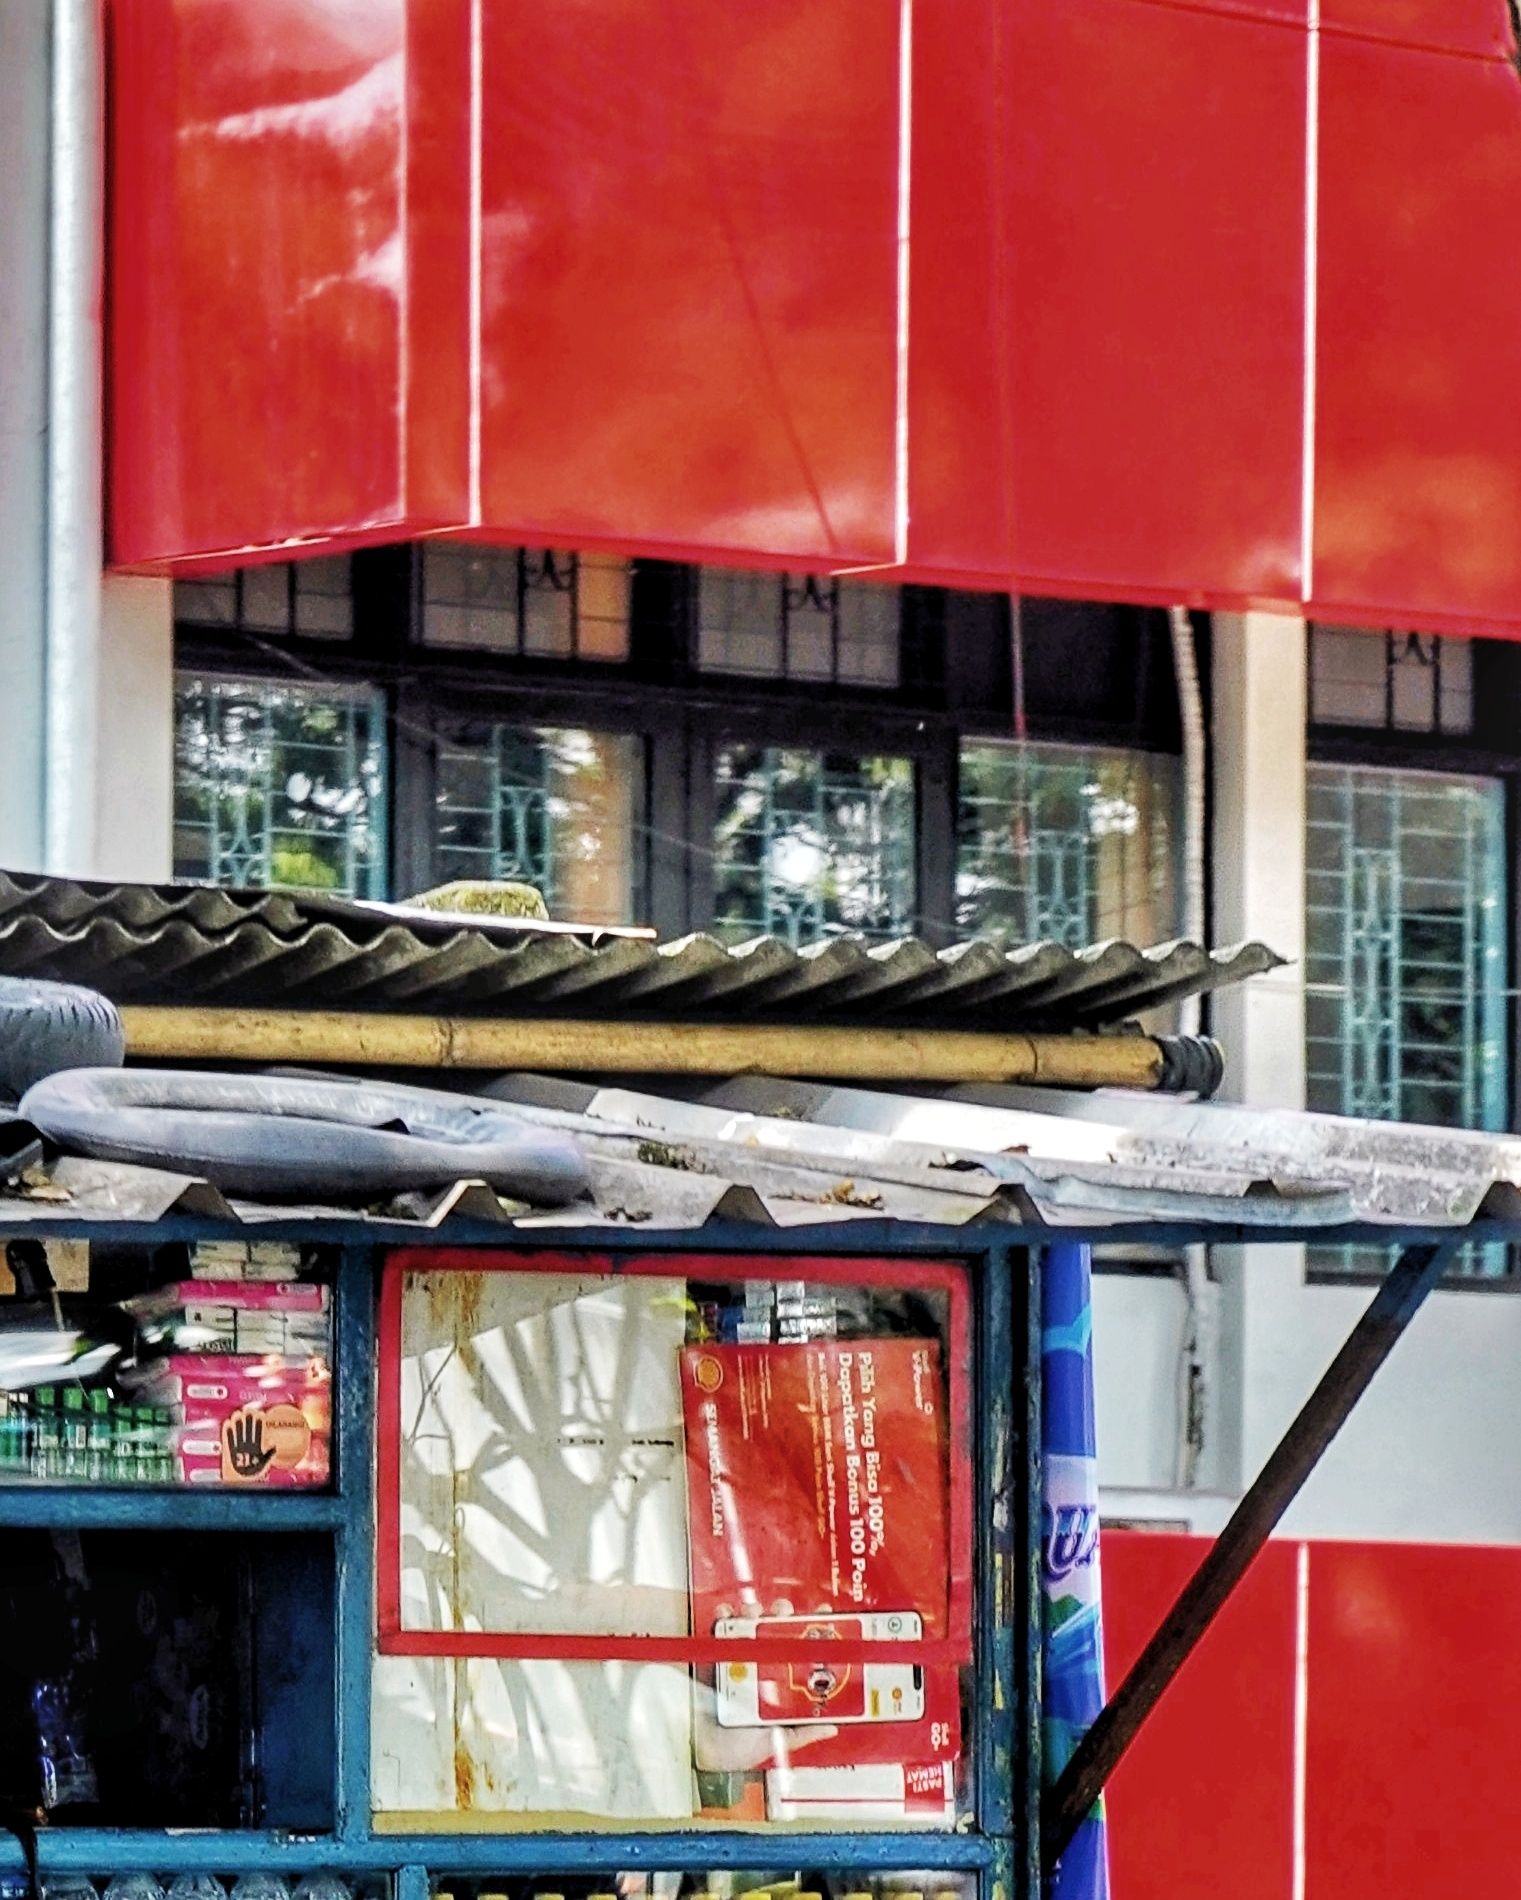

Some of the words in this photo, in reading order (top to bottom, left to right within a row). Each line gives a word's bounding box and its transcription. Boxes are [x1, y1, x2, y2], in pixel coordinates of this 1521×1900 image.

[836, 1352, 857, 1450] Dapatkan
[860, 1398, 878, 1447] Yang
[845, 1455, 861, 1515] Bonus
[866, 1451, 881, 1493] Bisa
[850, 1519, 864, 1553] 100
